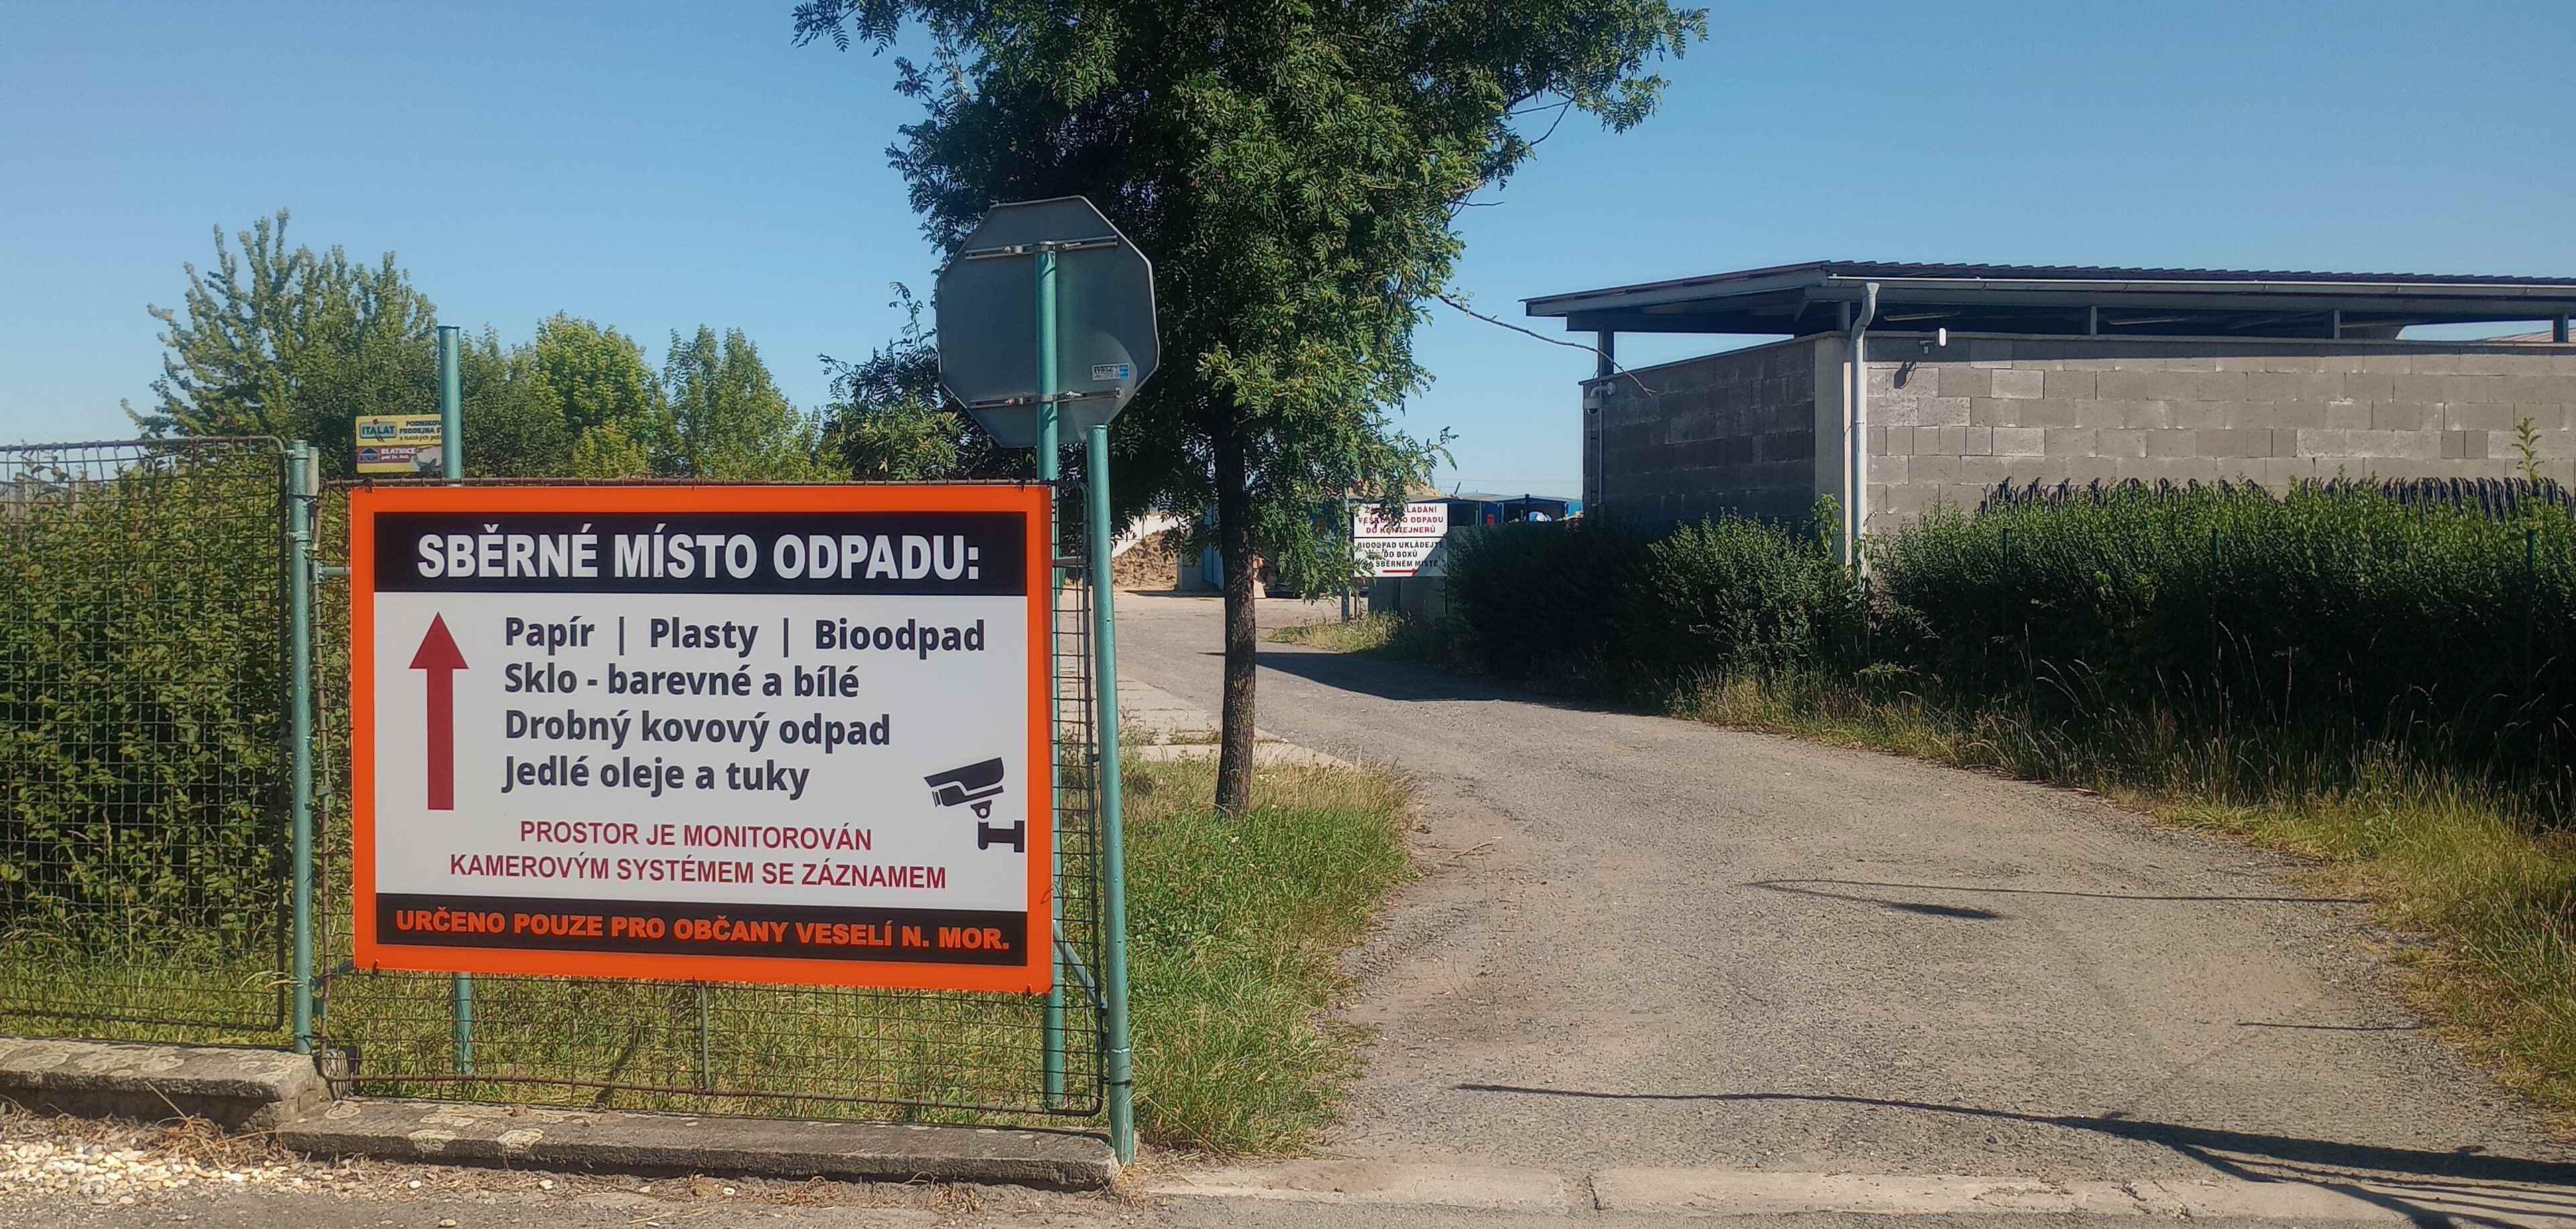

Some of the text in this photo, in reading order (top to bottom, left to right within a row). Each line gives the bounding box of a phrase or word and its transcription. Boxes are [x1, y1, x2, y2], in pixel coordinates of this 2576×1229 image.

[362, 425, 395, 434] ITALAT
[418, 523, 980, 580] SBĚRNÉ MÍSTO ODPADU:
[1396, 549, 1418, 558] BOXŮ
[506, 616, 595, 656] Papír
[650, 617, 759, 658] Plasty
[816, 617, 985, 660] Bioodpad
[505, 662, 577, 693] Sklo
[608, 663, 751, 696] barevné
[762, 673, 782, 696] a
[794, 664, 859, 698] bílé
[506, 709, 890, 754] Drobný kovový odpad
[501, 755, 810, 801] Jedlé oleje a tuky
[520, 820, 871, 851] PROSTOR JE MONITOROVÁN
[450, 851, 946, 890] KAMEROVÝM SYSTÉMEM SE ZÁZNAMEM
[396, 906, 1010, 951] URČENO POUZE PRO OBČANY VESELÍ N. MOR.
